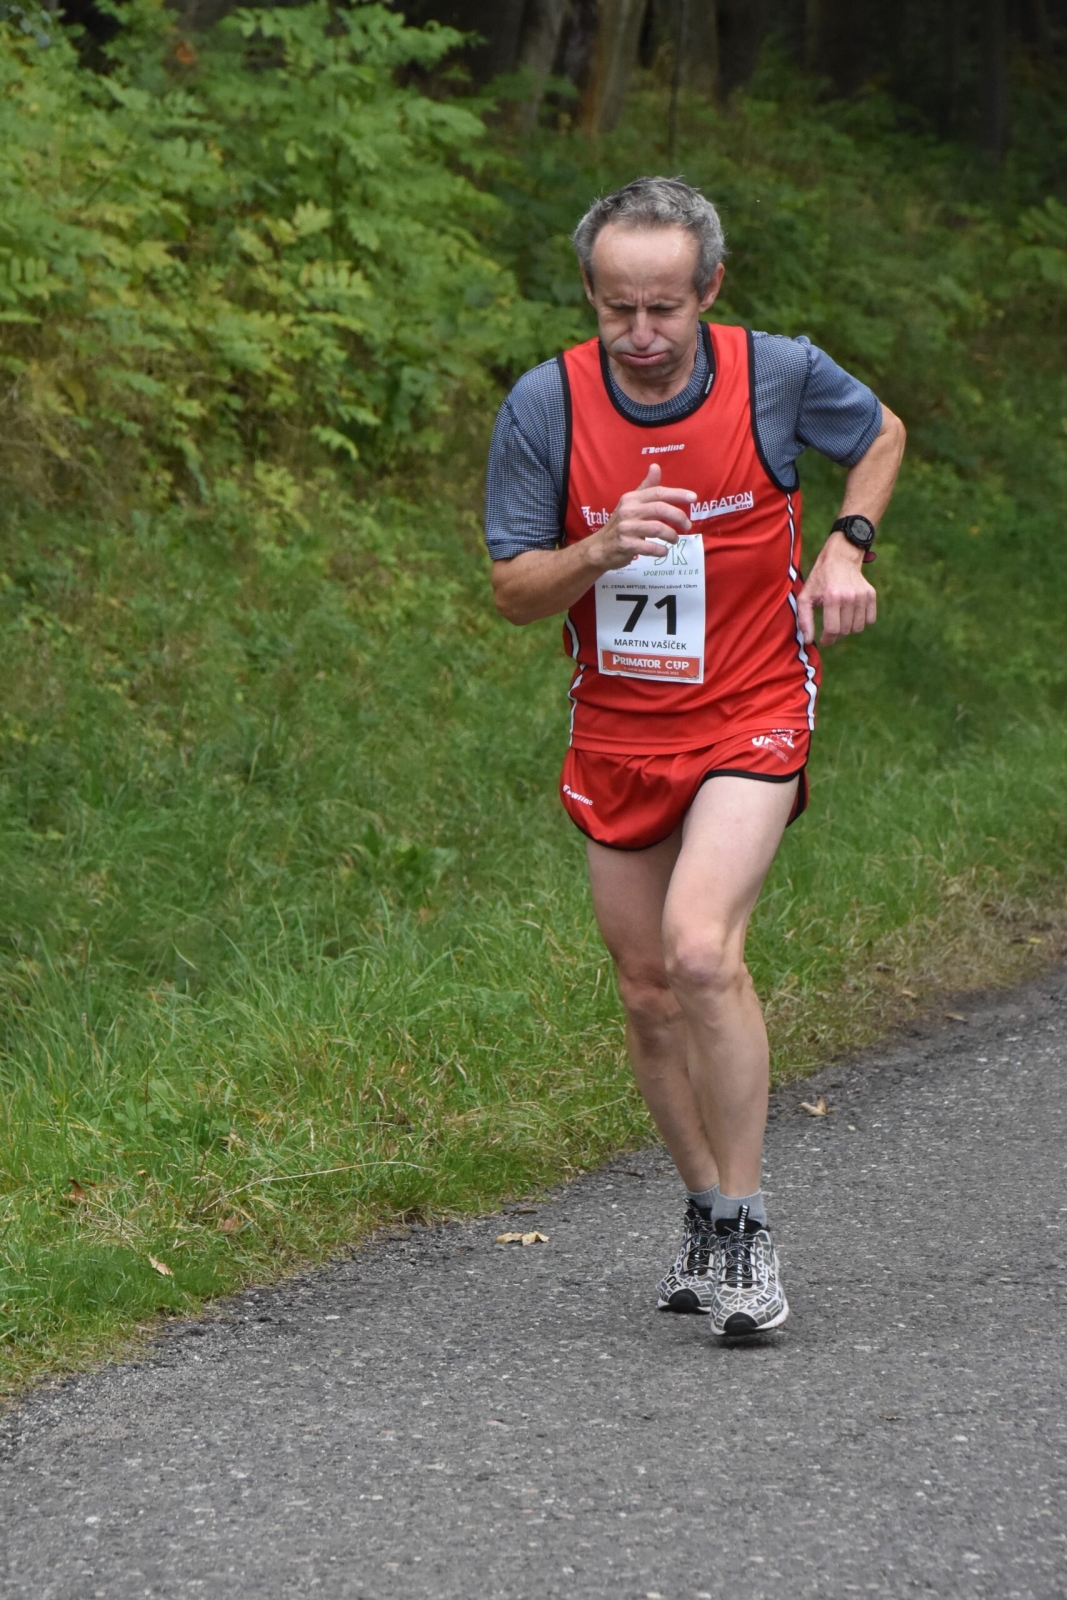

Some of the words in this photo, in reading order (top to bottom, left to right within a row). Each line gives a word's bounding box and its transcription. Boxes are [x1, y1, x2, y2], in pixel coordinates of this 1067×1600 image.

[690, 490, 753, 513] MARATON
[735, 502, 752, 510] stav
[581, 506, 613, 527] Krak
[616, 594, 677, 635] 71
[613, 638, 649, 648] MARTIN
[651, 640, 687, 650] VAŠÍČEK
[612, 654, 661, 669] PRIMATOR
[665, 660, 690, 671] CUP
